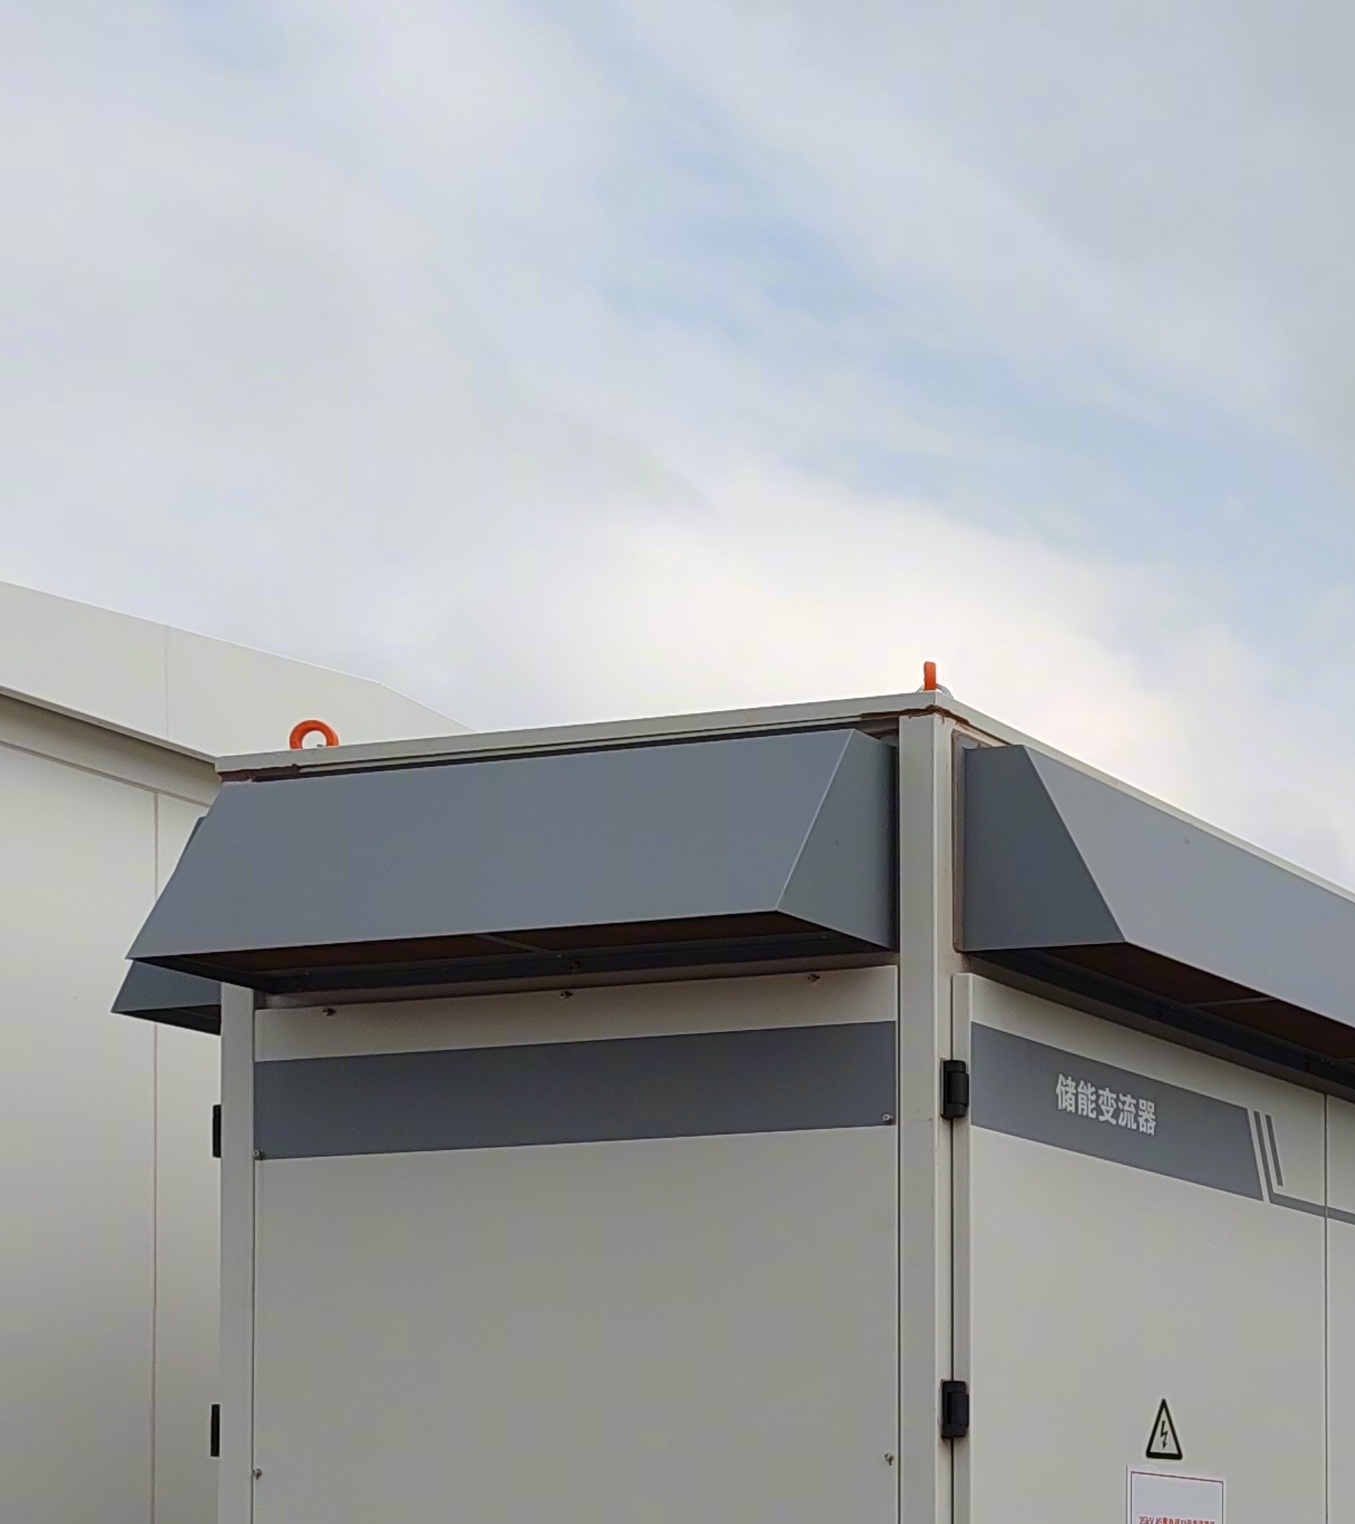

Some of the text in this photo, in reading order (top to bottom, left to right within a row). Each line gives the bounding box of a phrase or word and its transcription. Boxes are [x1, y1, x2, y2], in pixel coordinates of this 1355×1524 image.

[1056, 1073, 1157, 1136] 储能变流器
